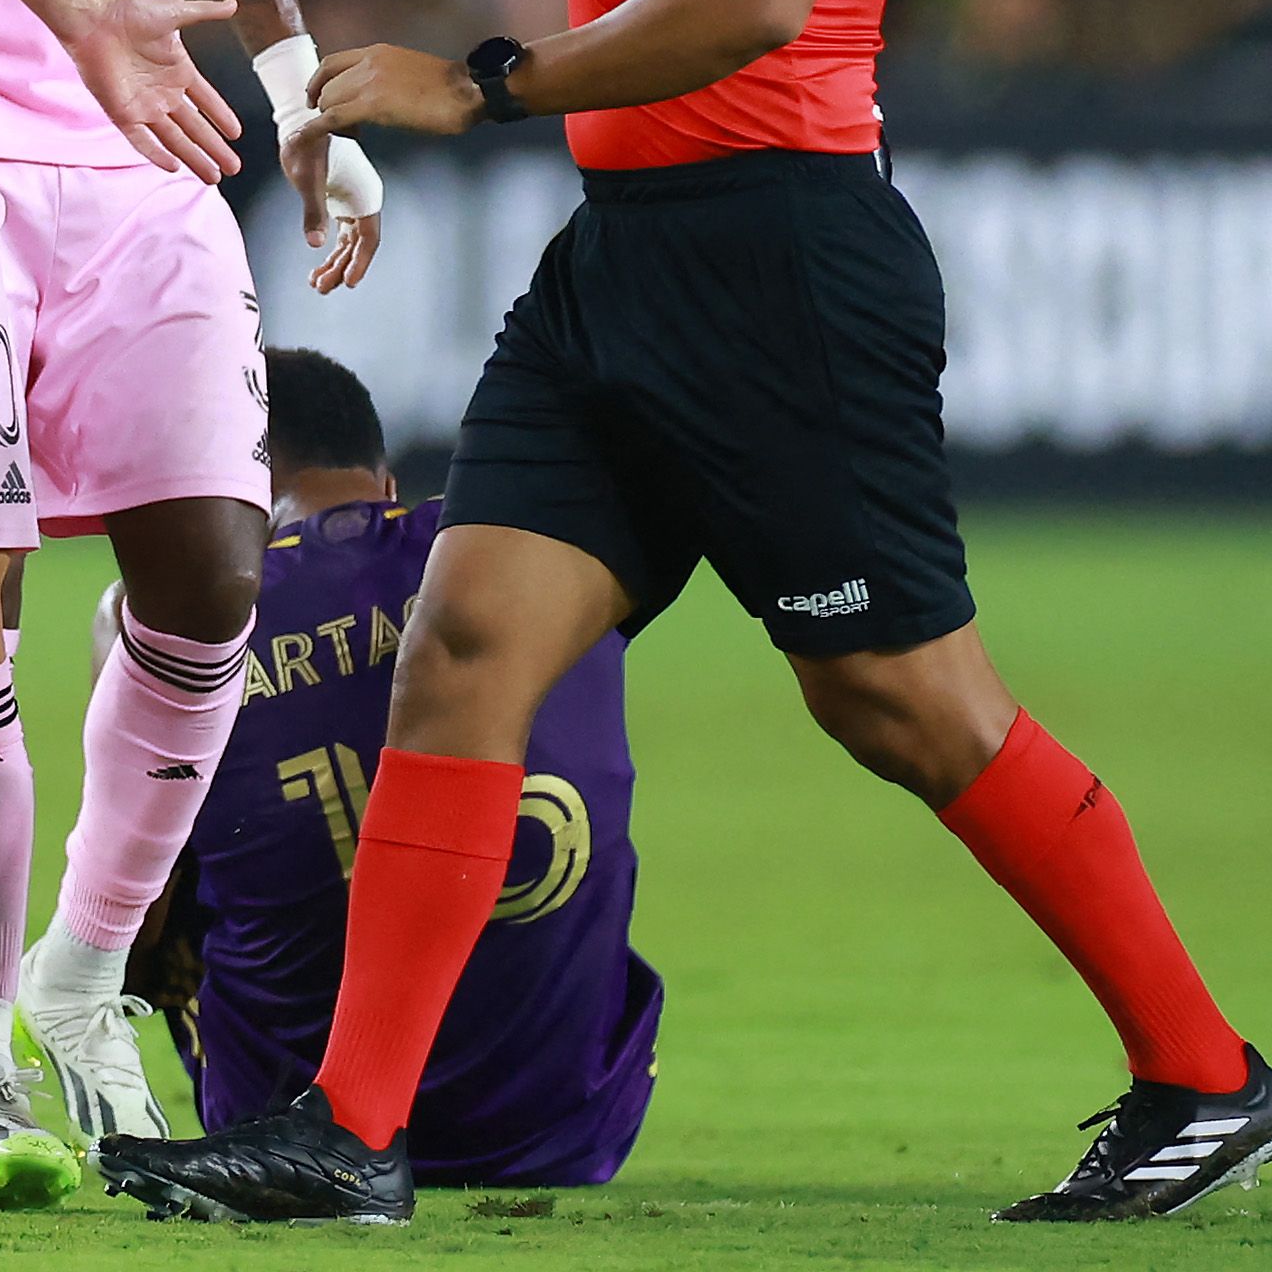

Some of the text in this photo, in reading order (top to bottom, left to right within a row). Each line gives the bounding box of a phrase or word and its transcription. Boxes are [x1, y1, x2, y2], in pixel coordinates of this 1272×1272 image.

[777, 578, 869, 617] capelli
[819, 601, 871, 618] SPORT
[241, 595, 419, 707] ARTA
